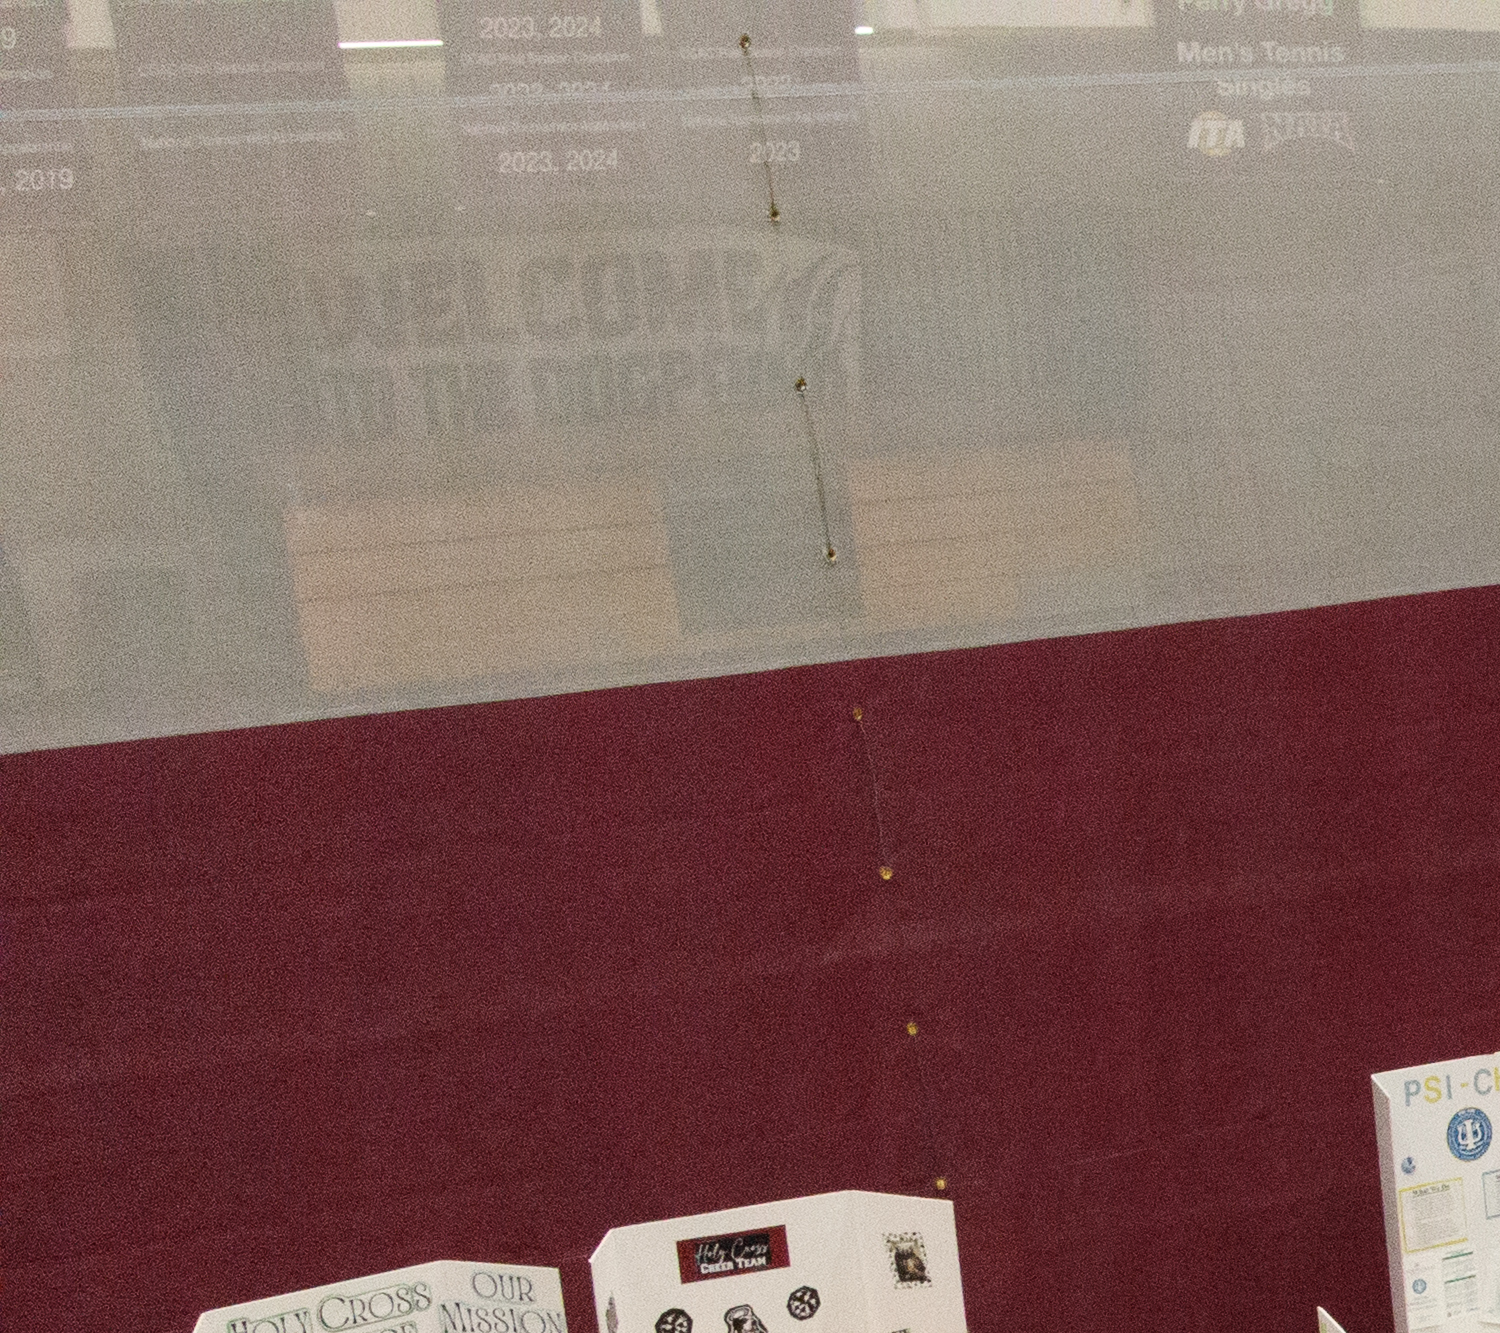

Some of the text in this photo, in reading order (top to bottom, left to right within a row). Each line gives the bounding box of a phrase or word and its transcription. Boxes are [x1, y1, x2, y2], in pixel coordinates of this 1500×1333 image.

[1176, 40, 1345, 63] Men's Tennis
[15, 169, 75, 192] 2019
[1404, 1074, 1453, 1107] PSI
[696, 1243, 726, 1264] Holy
[700, 1254, 767, 1275] CHEER TEAM
[472, 1270, 534, 1303] OUR
[318, 1281, 431, 1332] CROSS
